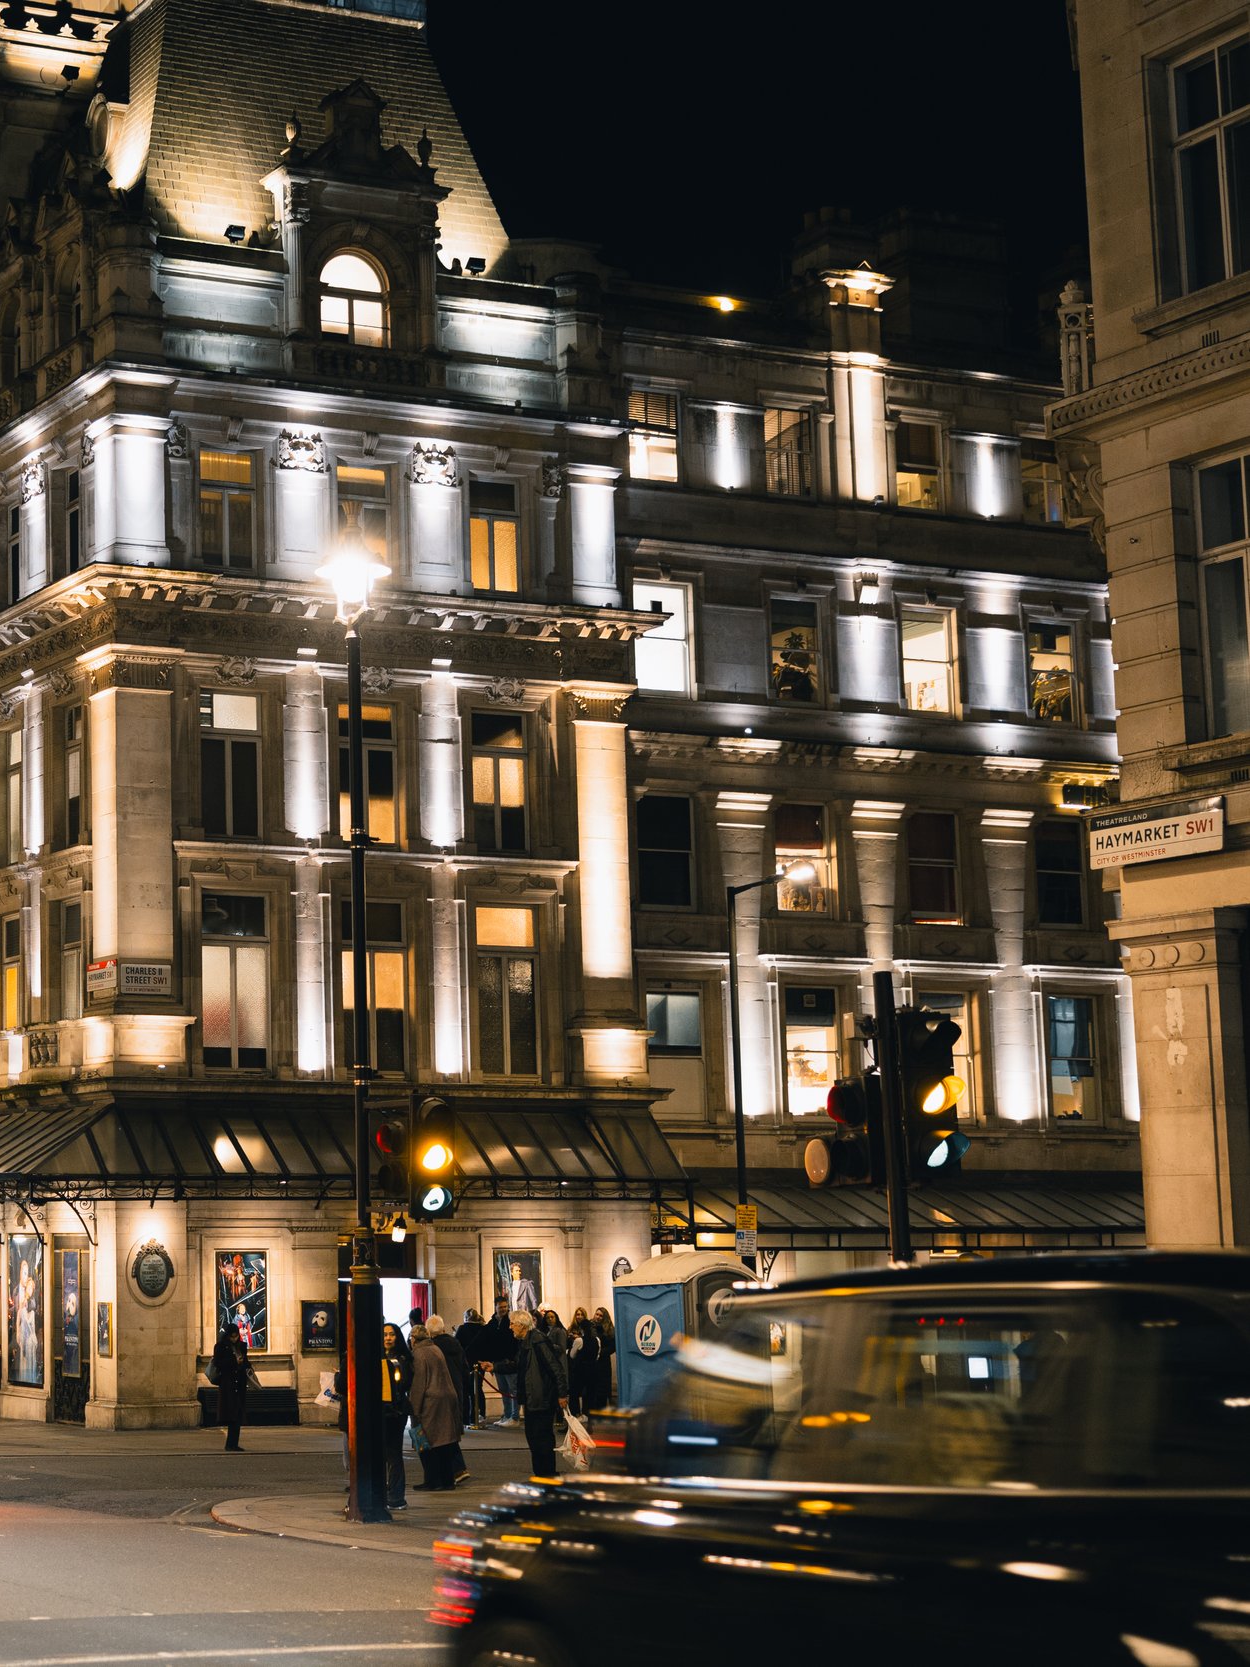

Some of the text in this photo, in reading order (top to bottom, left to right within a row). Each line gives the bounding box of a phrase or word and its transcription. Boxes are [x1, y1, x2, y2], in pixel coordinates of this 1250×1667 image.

[1096, 813, 1148, 828] THEATRELAND
[1096, 818, 1214, 850] HAYMARKET SW1
[1096, 857, 1111, 866] CITY
[1121, 848, 1167, 861] WESTMINSTER
[125, 967, 163, 976] CHARLES II
[125, 976, 168, 985] STREET SW1
